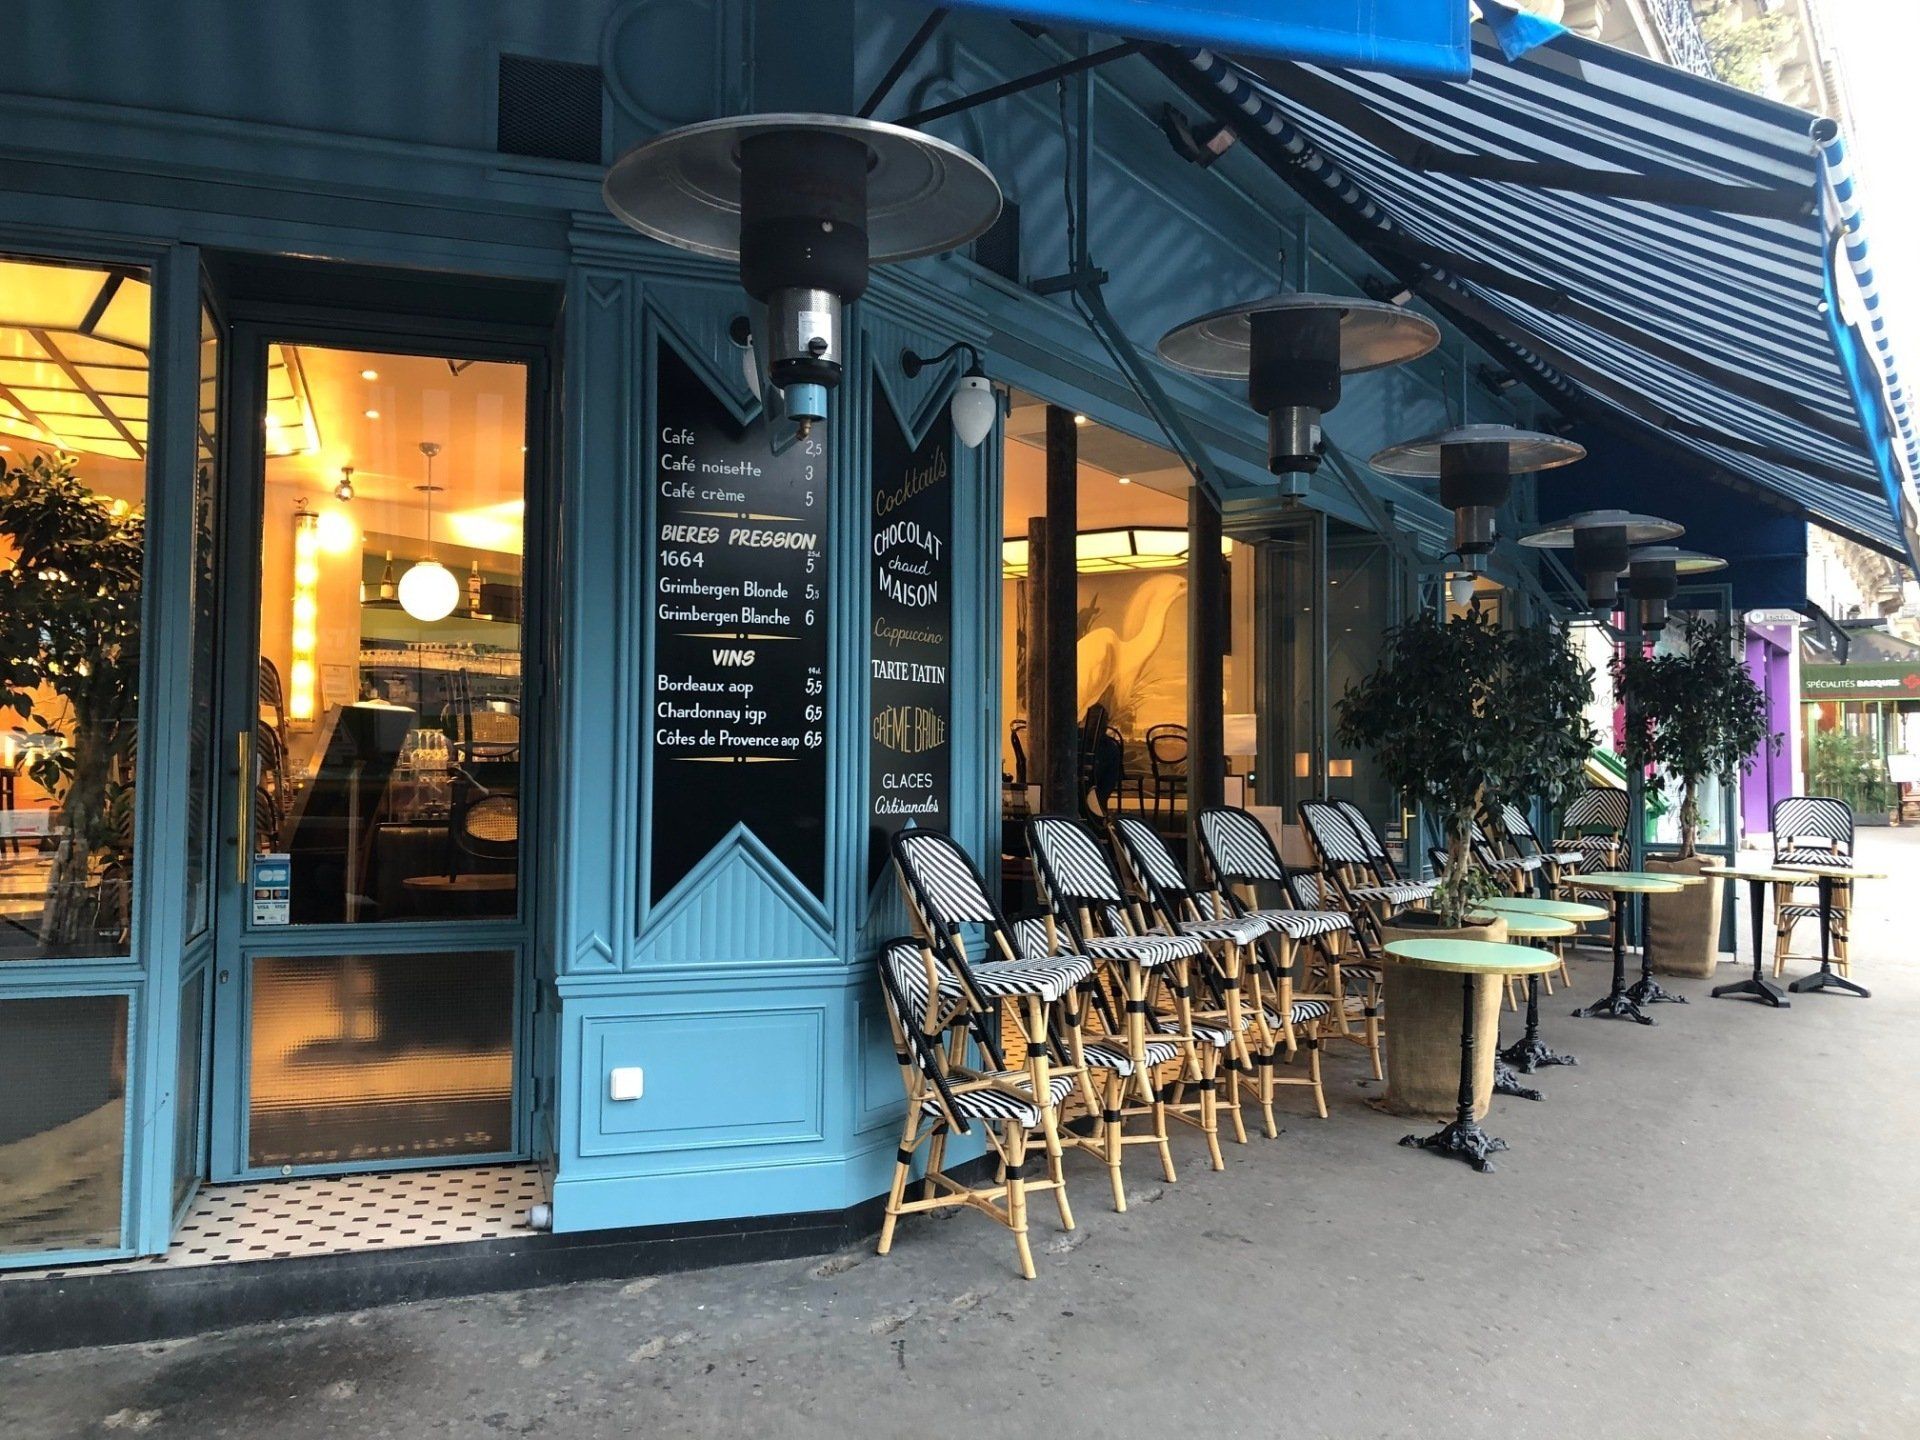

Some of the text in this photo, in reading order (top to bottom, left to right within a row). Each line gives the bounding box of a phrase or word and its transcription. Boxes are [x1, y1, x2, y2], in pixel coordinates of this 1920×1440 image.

[662, 427, 822, 458] Café 2,5
[661, 454, 814, 481] Café noisette 3
[876, 445, 947, 516] Cocktails
[661, 481, 814, 507] Café crème 5
[661, 524, 817, 550] BIERES PRESSION
[874, 521, 943, 561] CHOCOLAT
[660, 550, 815, 574] 1664 5
[888, 555, 931, 576] chaud
[659, 576, 820, 600] Grimbergen Blonde 5,5
[879, 566, 938, 607] MAISON
[658, 603, 815, 627] Grimbergen Blanche 6
[874, 616, 943, 647] Cappuccino
[712, 649, 756, 667] VINS
[872, 659, 945, 684] TARTE TATIN
[1806, 679, 1855, 688] SPÉCIALITÉS
[657, 674, 823, 699] Bordeaux aop 5,5
[657, 702, 823, 725] Chardonnay igp 6,5
[656, 728, 823, 750] Côtes de Provence aop 6,5
[873, 705, 946, 753] CRÈME BRÛLÉE
[882, 773, 933, 789] GLACES
[874, 795, 939, 815] Artisanales
